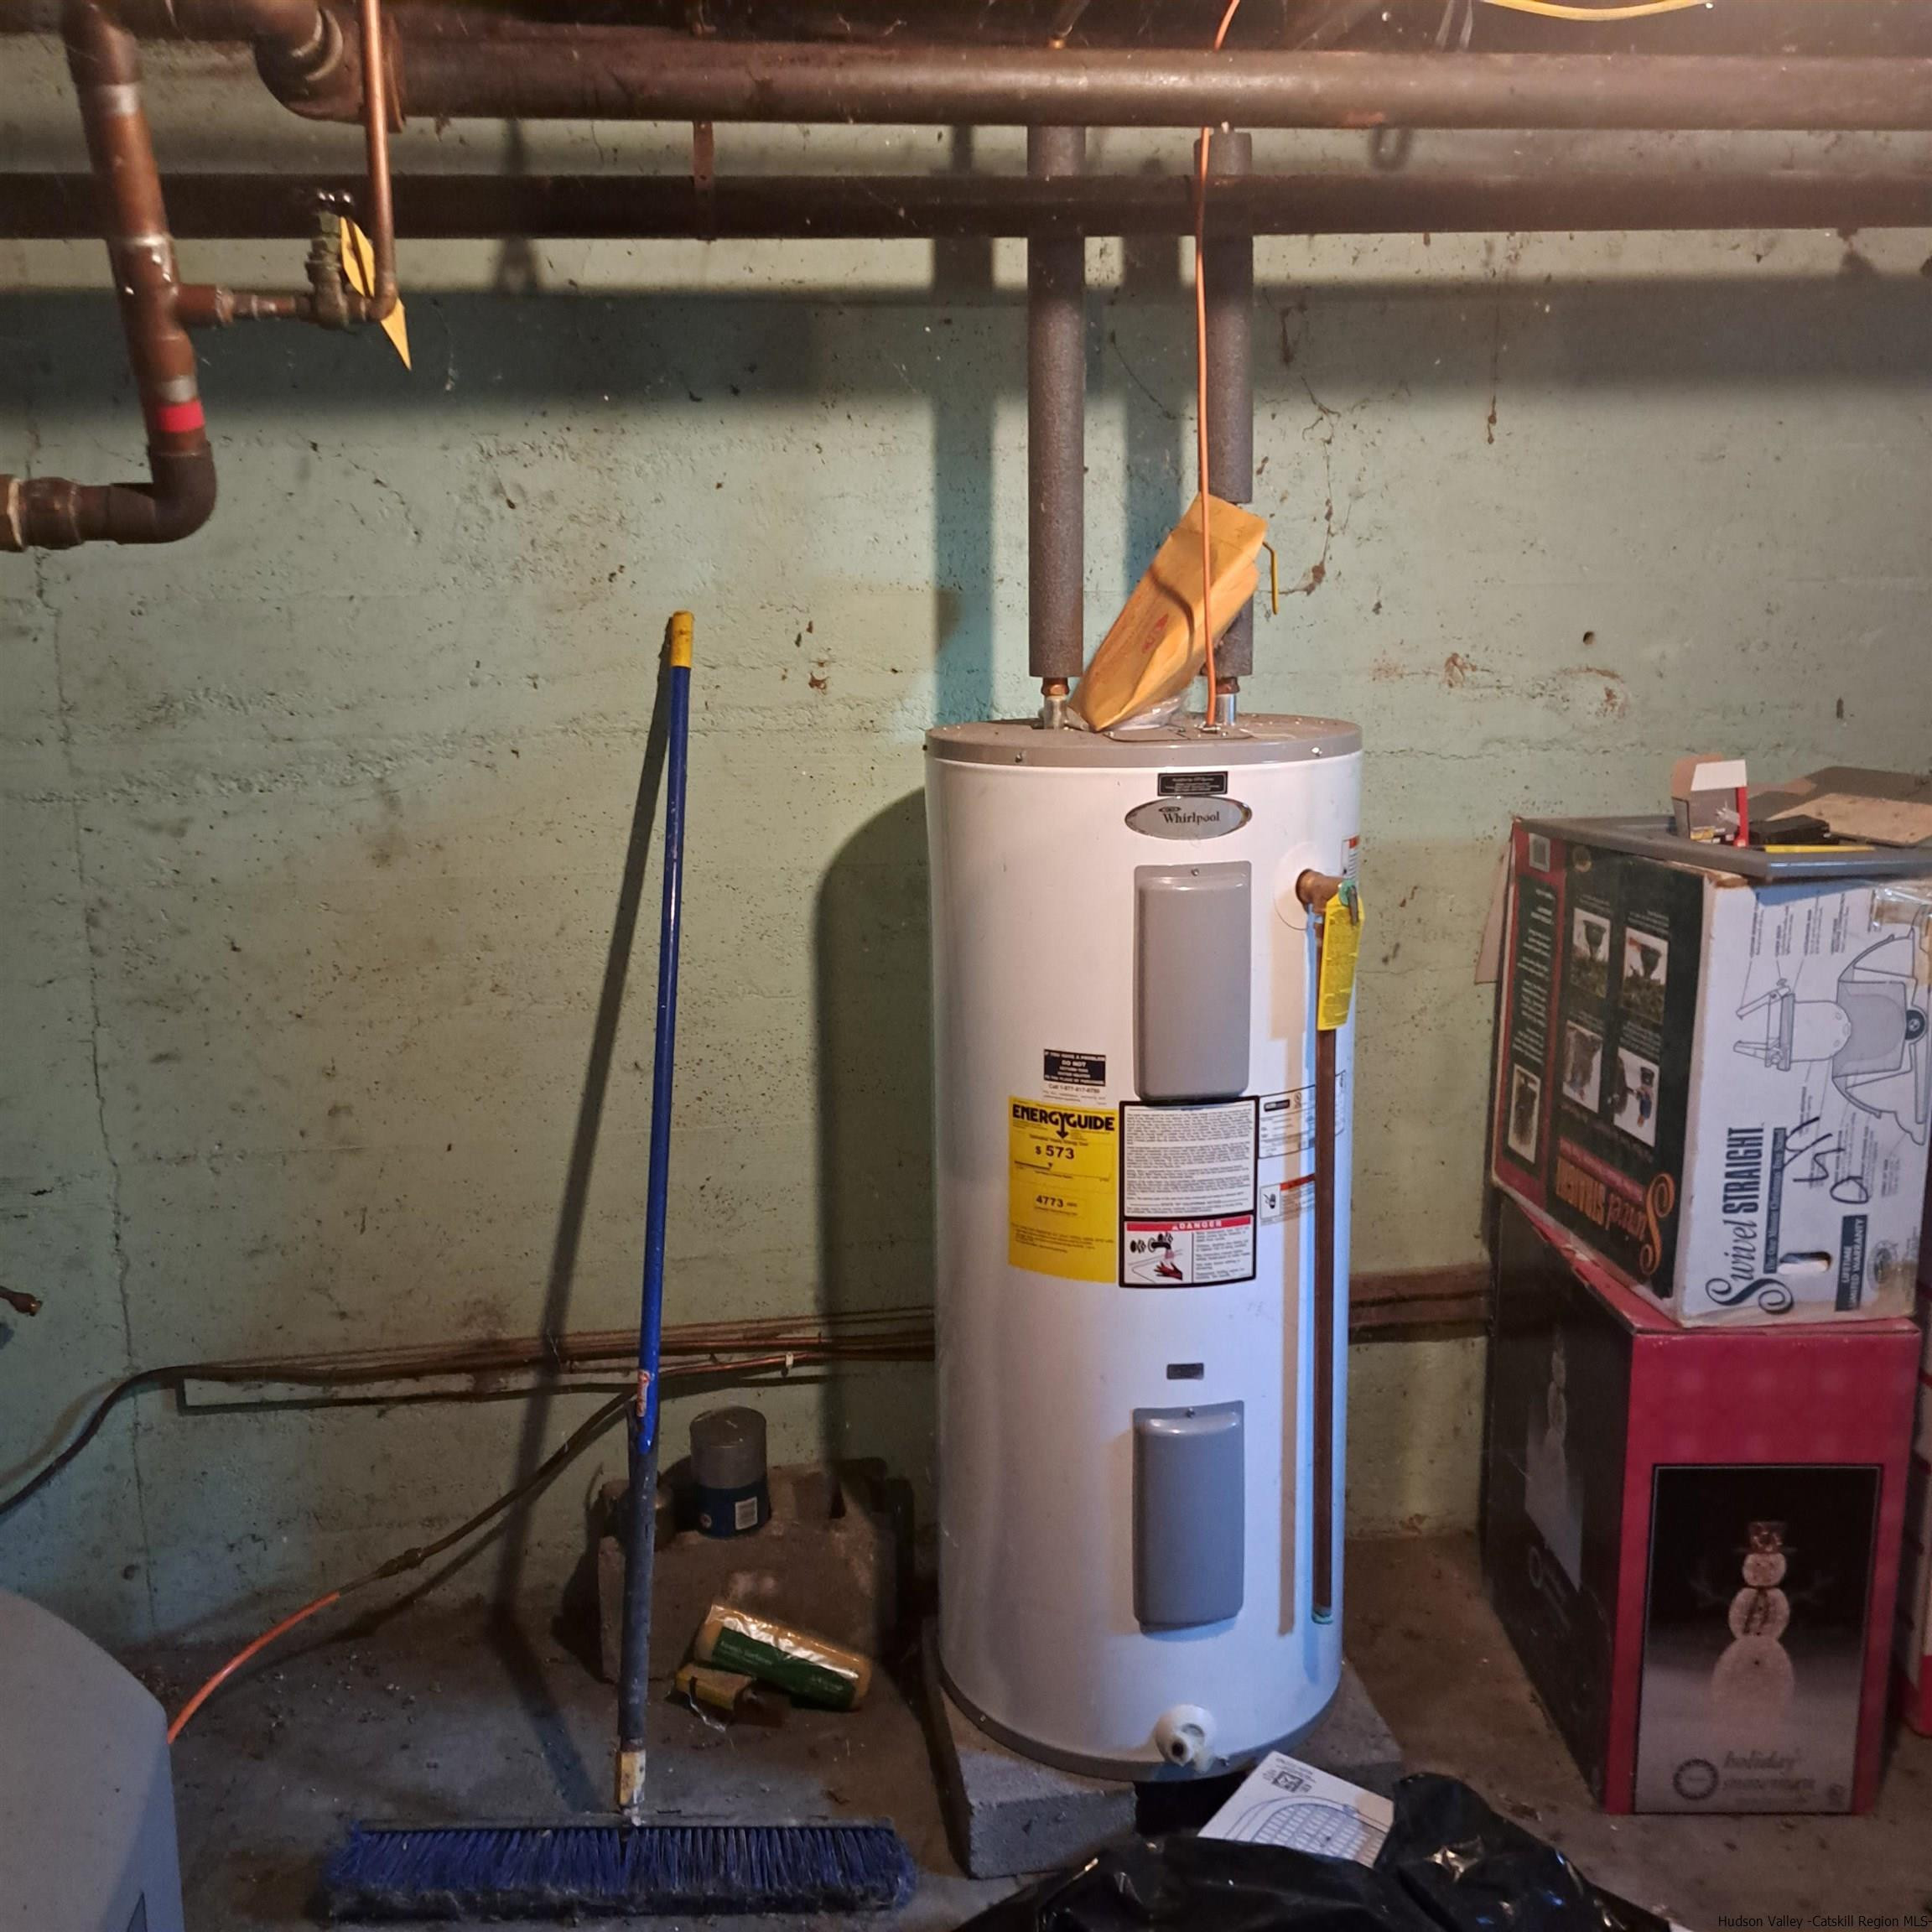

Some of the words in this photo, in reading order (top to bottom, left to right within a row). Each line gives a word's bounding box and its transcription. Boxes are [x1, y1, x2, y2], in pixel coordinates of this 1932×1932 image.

[1163, 811, 1219, 825] Whirlpool
[1046, 1145, 1074, 1160] 573
[1722, 1127, 1763, 1214] STRAIGHT
[1036, 1195, 1064, 1208] 4773
[1179, 1220, 1222, 1230] DANGER
[1852, 1218, 1865, 1272] WARRANTY
[1705, 1219, 1794, 1315] Swivel
[1841, 1246, 1852, 1283] LIFETIME
